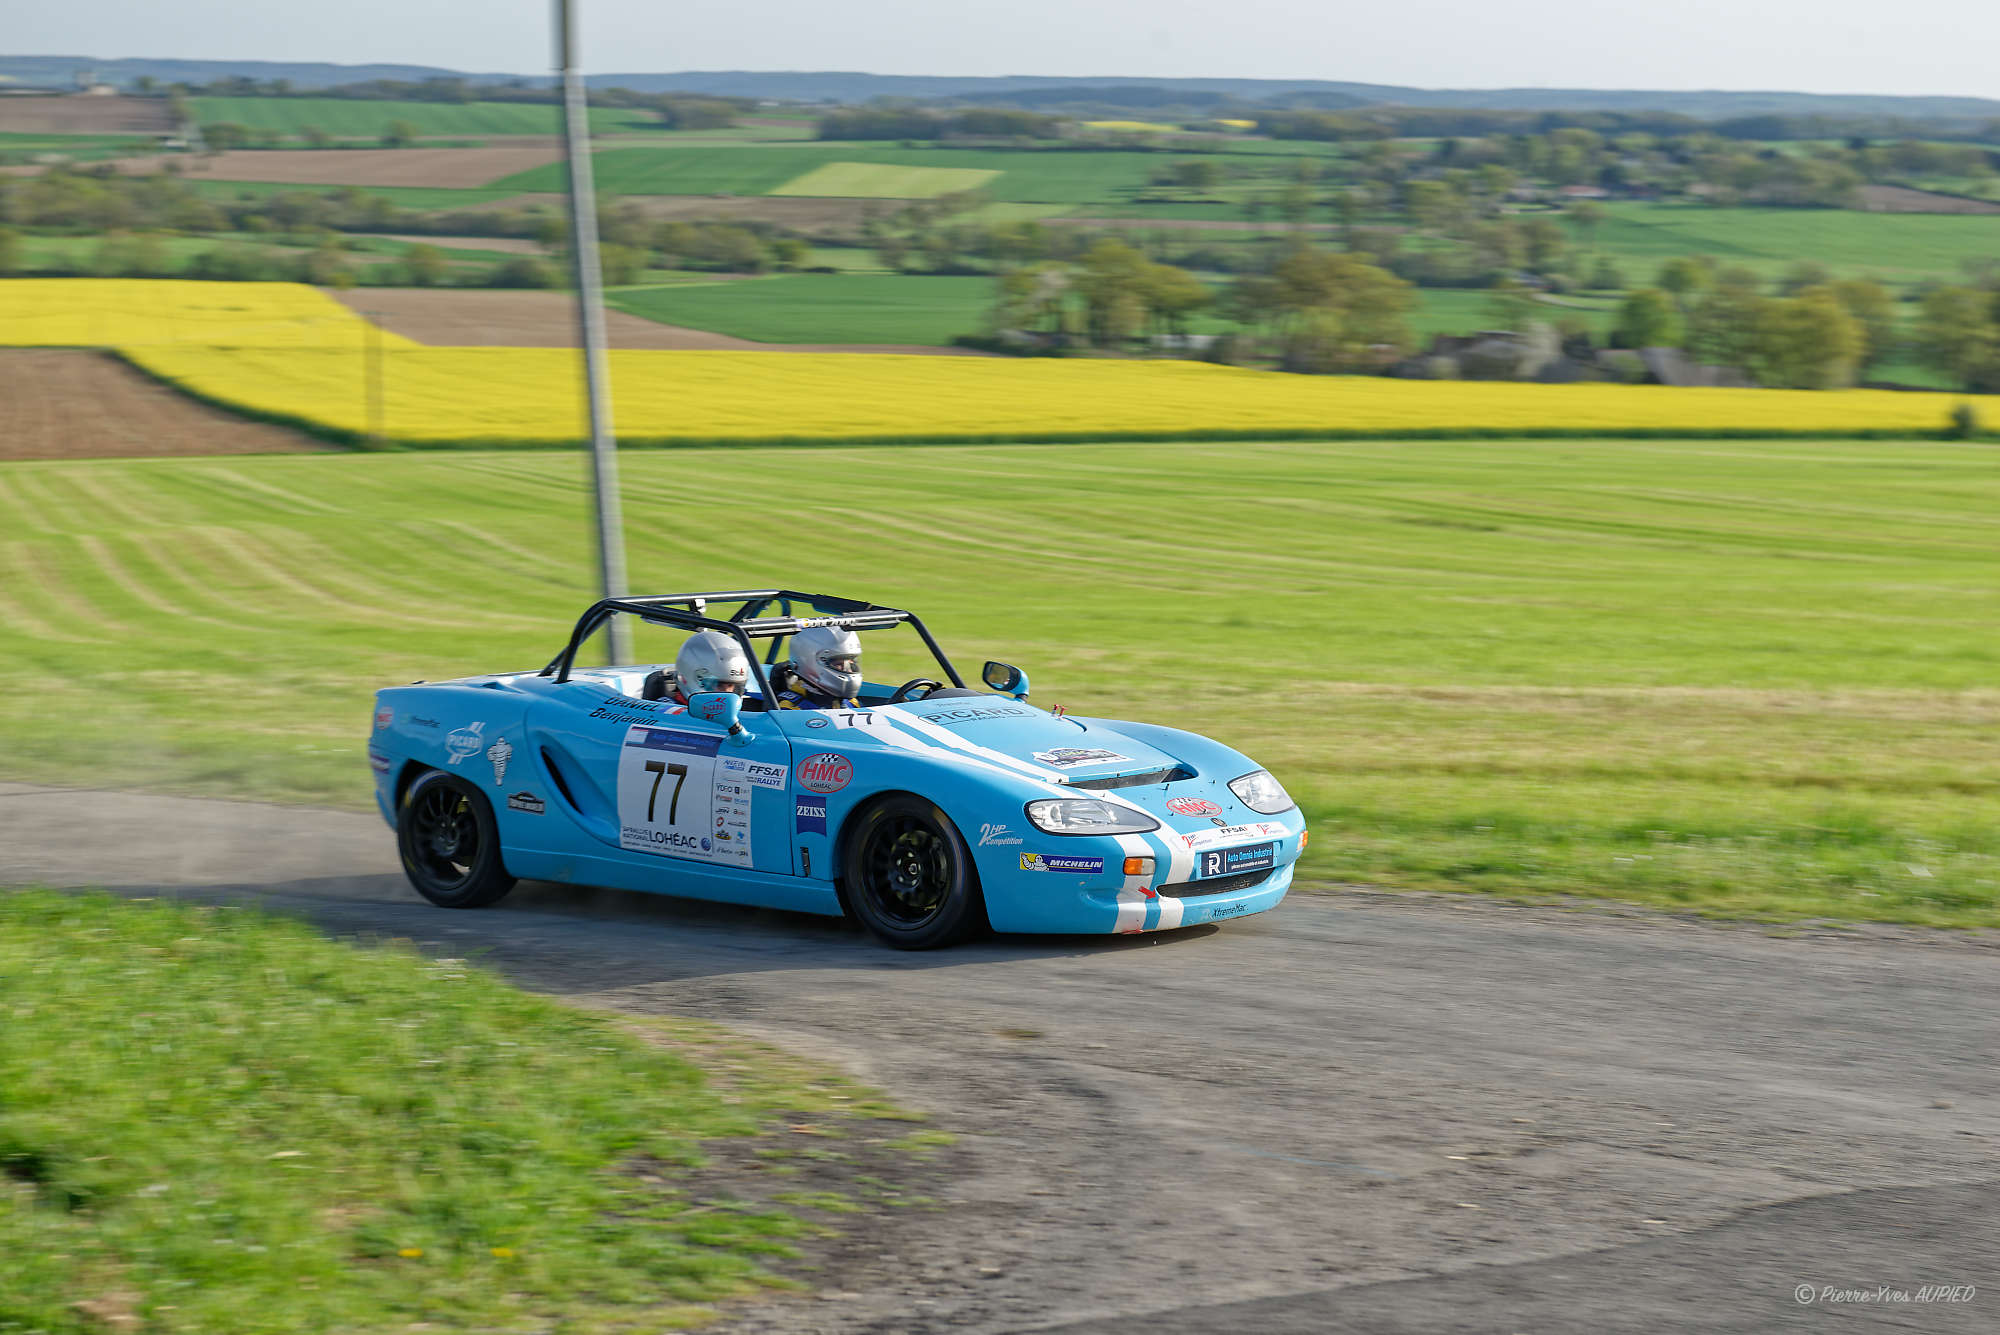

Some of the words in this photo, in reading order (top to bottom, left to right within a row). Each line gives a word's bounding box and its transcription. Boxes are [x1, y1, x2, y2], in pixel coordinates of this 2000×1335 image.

[589, 707, 659, 726] Benjamin
[838, 712, 873, 727] 77
[924, 708, 1025, 722] PICARD
[748, 765, 781, 778] FFSA
[802, 761, 848, 783] HMC
[757, 777, 782, 787] RALLYE
[644, 760, 688, 825] 77
[796, 805, 826, 818] ZEISS
[1172, 801, 1217, 814] HMC
[649, 829, 697, 849] LOHÉAC
[1049, 859, 1103, 868] MICHELIN
